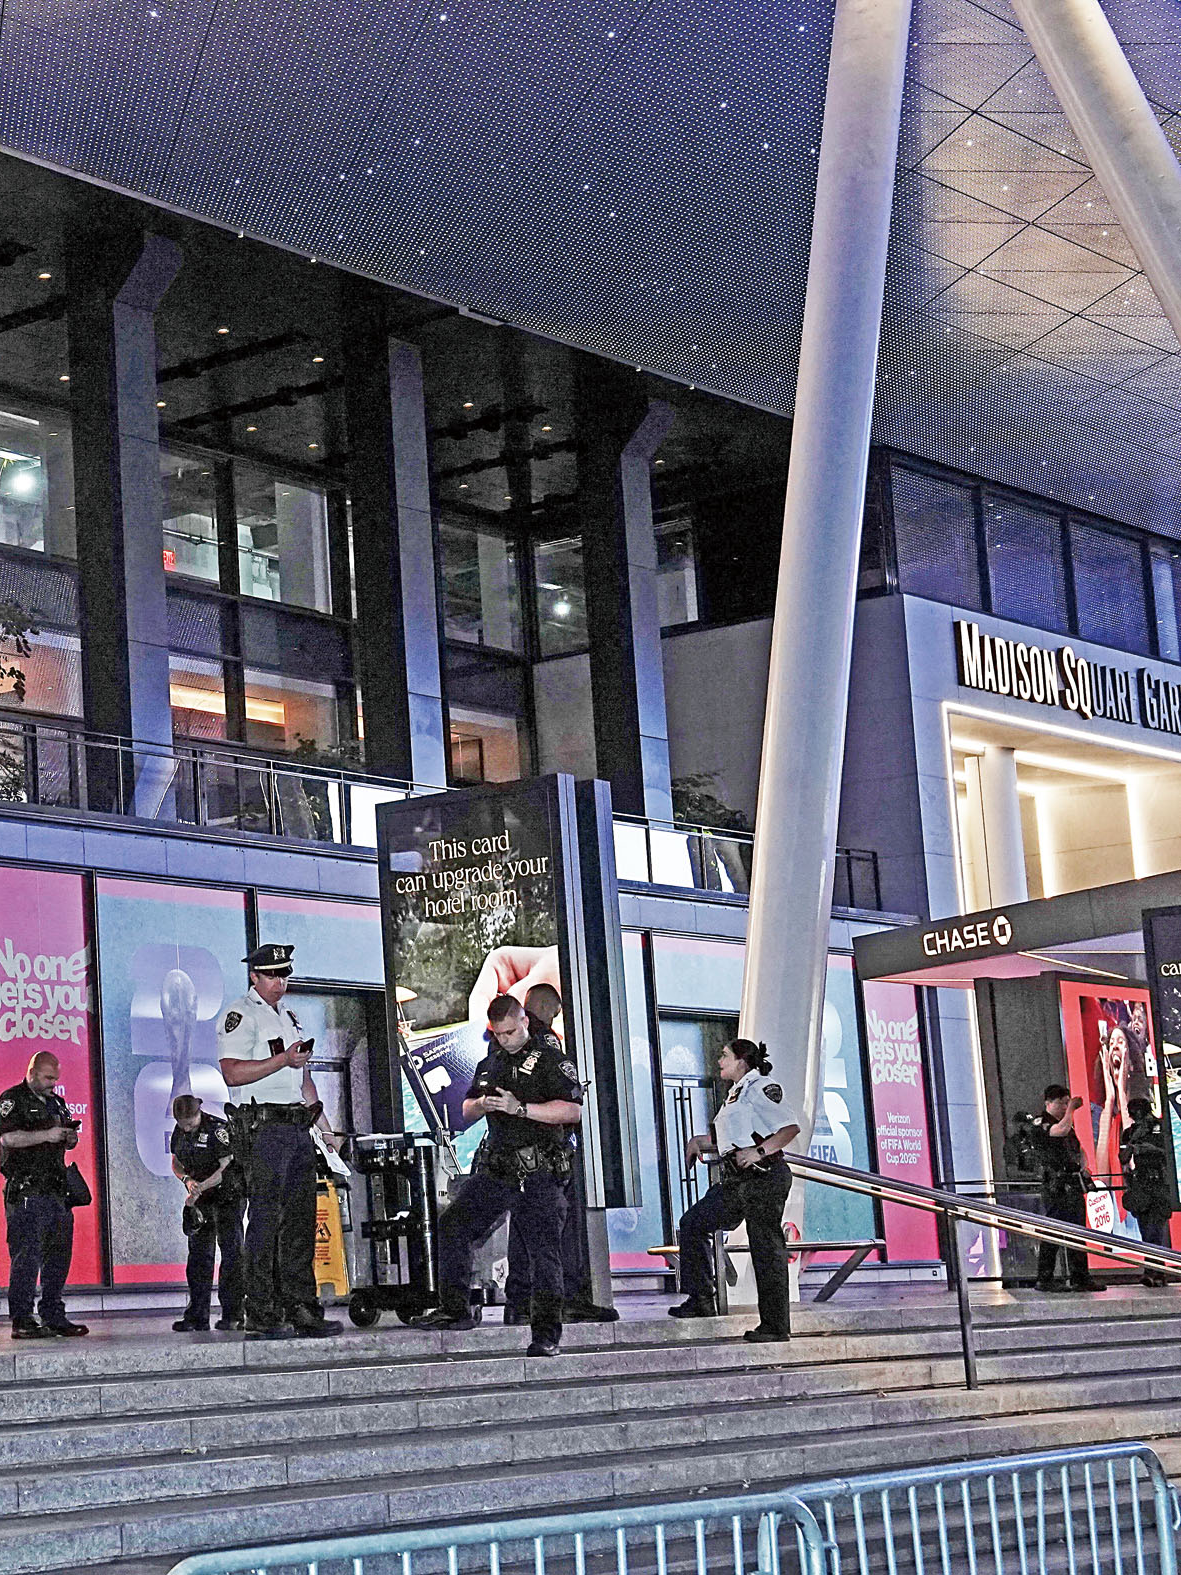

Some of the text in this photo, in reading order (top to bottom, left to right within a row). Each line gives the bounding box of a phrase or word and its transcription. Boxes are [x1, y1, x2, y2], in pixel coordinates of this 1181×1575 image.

[959, 619, 1181, 735] MADISON SQUARE GAR
[429, 829, 510, 862] This card
[395, 856, 548, 894] can upgrade your
[424, 889, 522, 918] hotel room.
[923, 922, 991, 956] CHASE
[33, 946, 89, 983] one
[1160, 963, 1181, 976] ca
[43, 984, 93, 1018] you
[866, 1010, 918, 1041] No one
[894, 1042, 921, 1066] you
[872, 1061, 918, 1088] closer
[876, 1124, 923, 1138] official sponsor
[887, 1111, 911, 1124] Verizon
[811, 1144, 838, 1163] FIFA
[880, 1138, 922, 1150] of FIFA World
[886, 1152, 899, 1166] Cup
[1094, 1211, 1111, 1229] 2016
